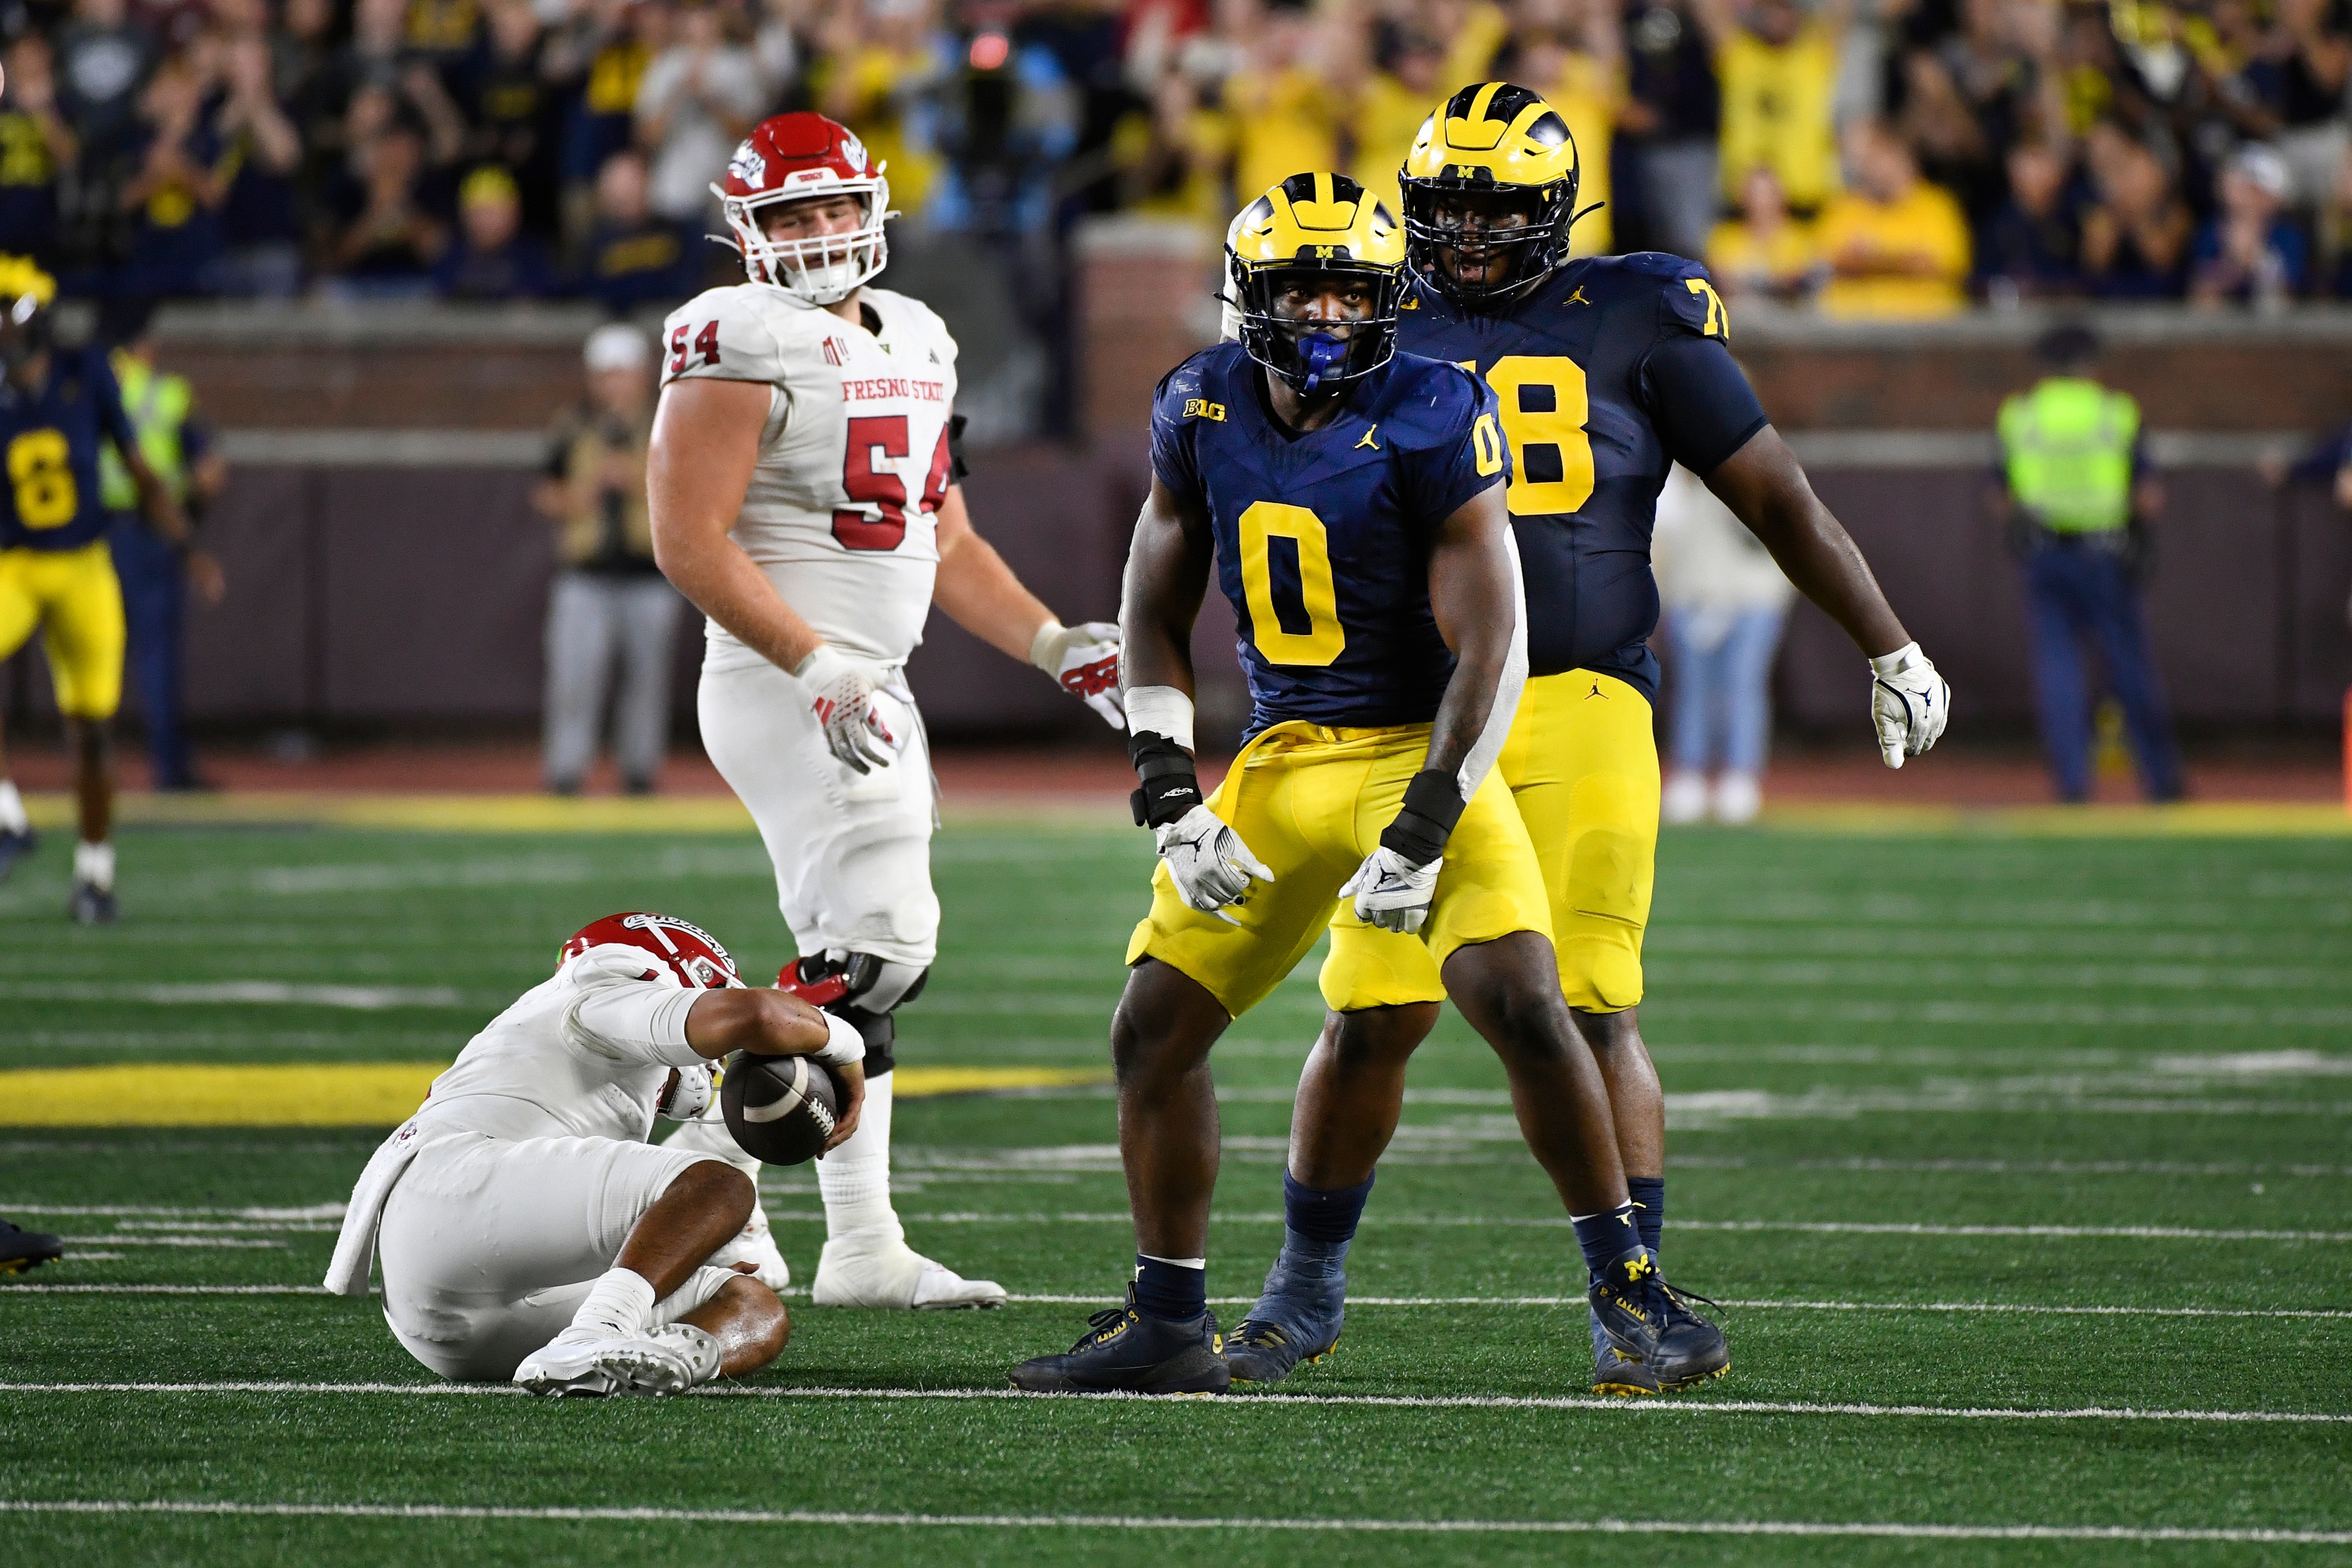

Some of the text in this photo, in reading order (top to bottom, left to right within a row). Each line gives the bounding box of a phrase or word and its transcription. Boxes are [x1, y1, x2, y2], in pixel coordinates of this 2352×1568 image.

[1457, 166, 1475, 178] M
[1316, 246, 1334, 258] M
[1686, 279, 1729, 339] 7
[671, 320, 721, 373] 54
[842, 378, 944, 403] FRESNO STATE
[1472, 413, 1503, 477] 0
[1239, 501, 1346, 666] 0
[1624, 1253, 1648, 1282] M
